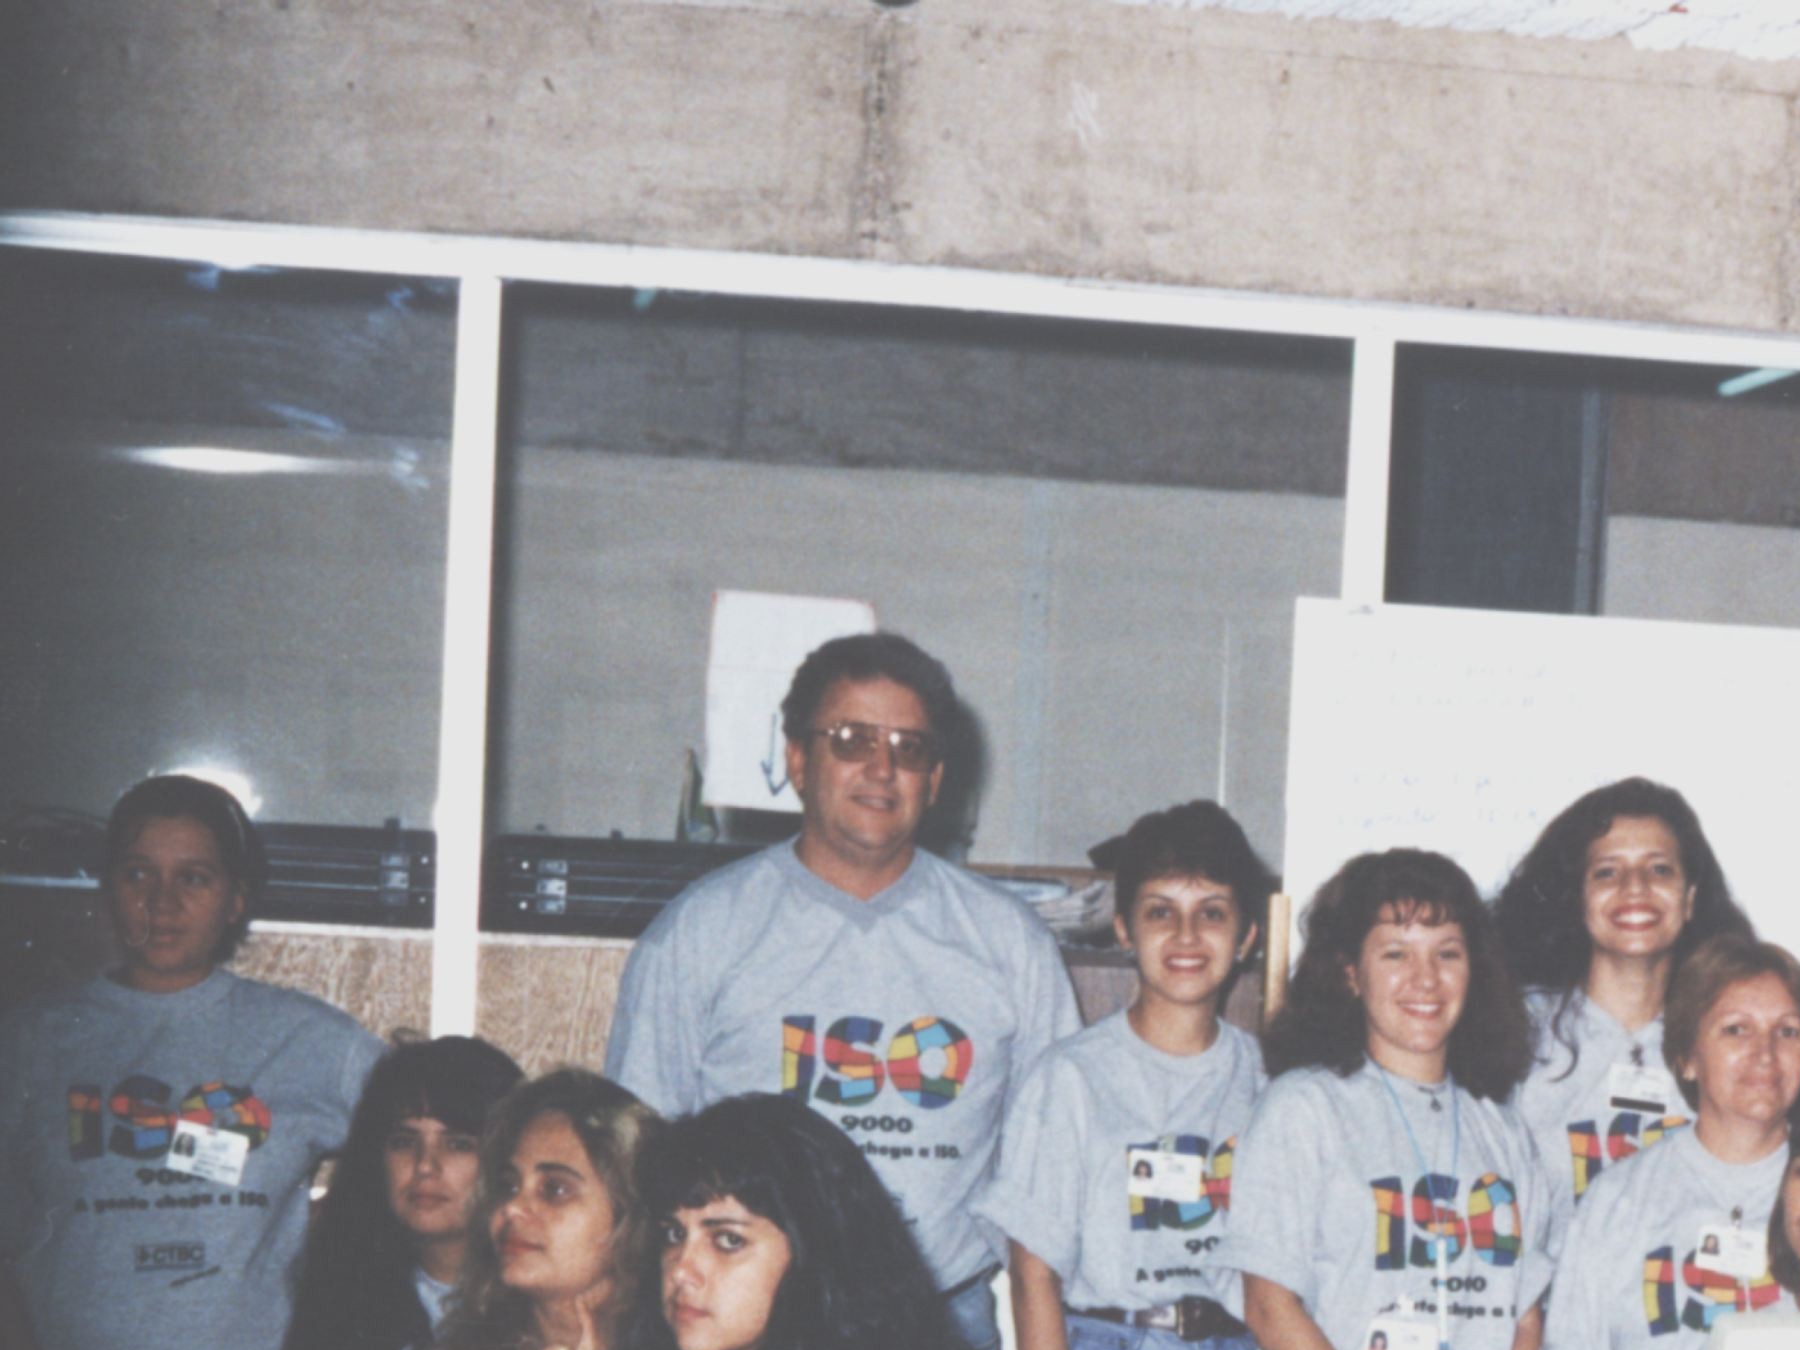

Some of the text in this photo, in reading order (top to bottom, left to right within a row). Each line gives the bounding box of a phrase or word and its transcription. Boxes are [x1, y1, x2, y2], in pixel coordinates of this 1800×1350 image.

[782, 1015, 974, 1110] ISO
[69, 1075, 271, 1163] ISO
[841, 1115, 914, 1134] 9000
[1370, 1172, 1522, 1270] ISO
